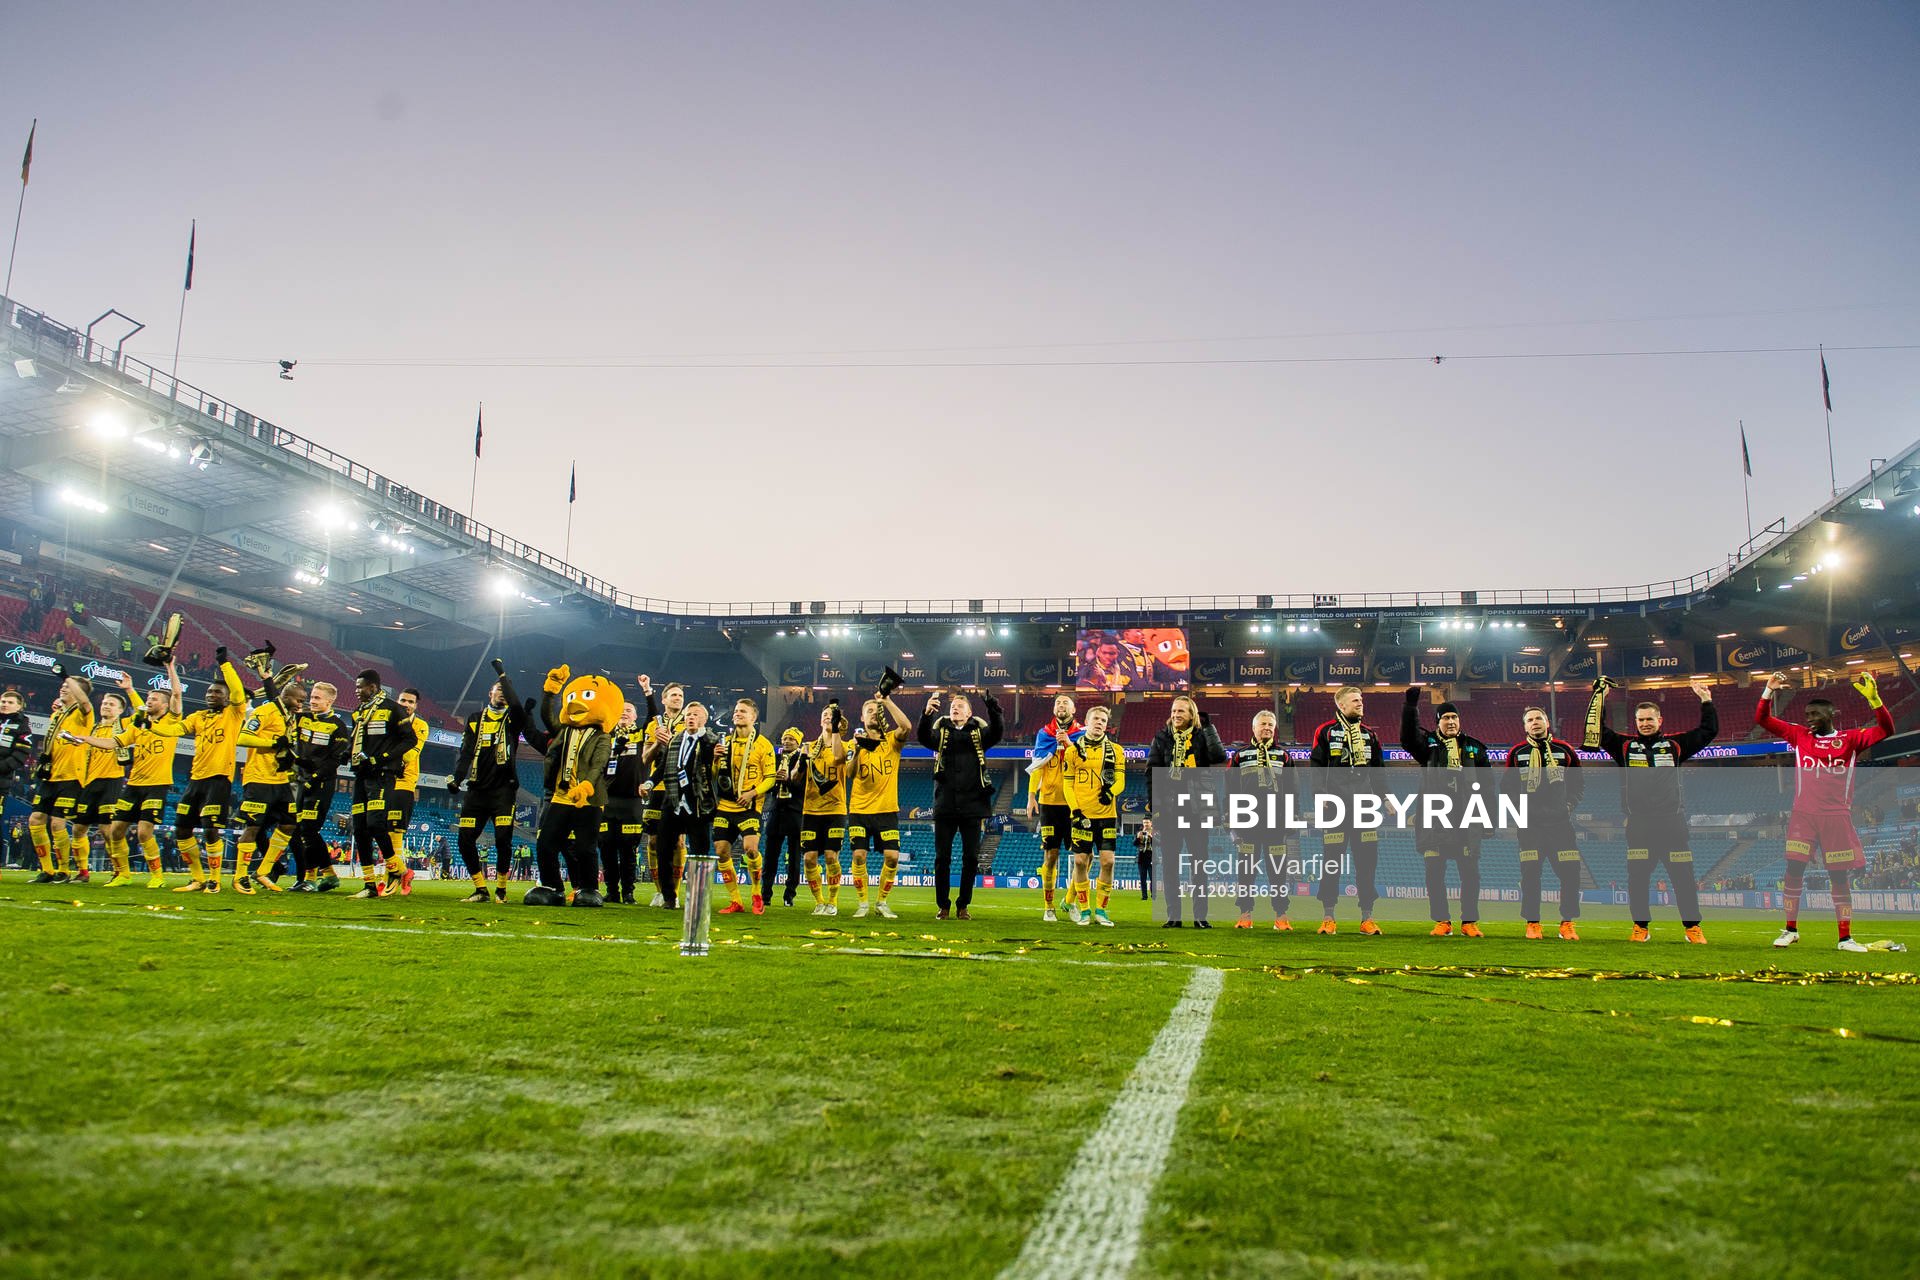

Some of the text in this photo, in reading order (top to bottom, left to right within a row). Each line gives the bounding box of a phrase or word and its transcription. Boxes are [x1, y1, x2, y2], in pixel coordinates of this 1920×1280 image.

[135, 497, 169, 517] telenor
[243, 535, 271, 552] telenor
[1848, 624, 1871, 643] Bendit
[21, 651, 56, 667] telenor
[1642, 655, 1678, 667] bama
[1737, 646, 1766, 662] Bendit
[984, 665, 1010, 677] bam
[1203, 662, 1227, 676] Bendit
[1240, 664, 1271, 676] bama
[1329, 663, 1361, 675] bama
[1420, 663, 1454, 675] bama
[1512, 662, 1546, 675] bama
[1568, 656, 1595, 672] Bendit
[94, 665, 124, 681] teleno
[1290, 751, 1312, 760] REM
[1390, 751, 1414, 760] REM
[860, 755, 893, 783] DNB
[1803, 753, 1846, 778] DNB
[1079, 768, 1103, 789] DN
[916, 807, 934, 818] Bendi
[1386, 886, 1394, 897] VI
[1396, 886, 1428, 899] GRATULE
[1501, 889, 1519, 901] MED
